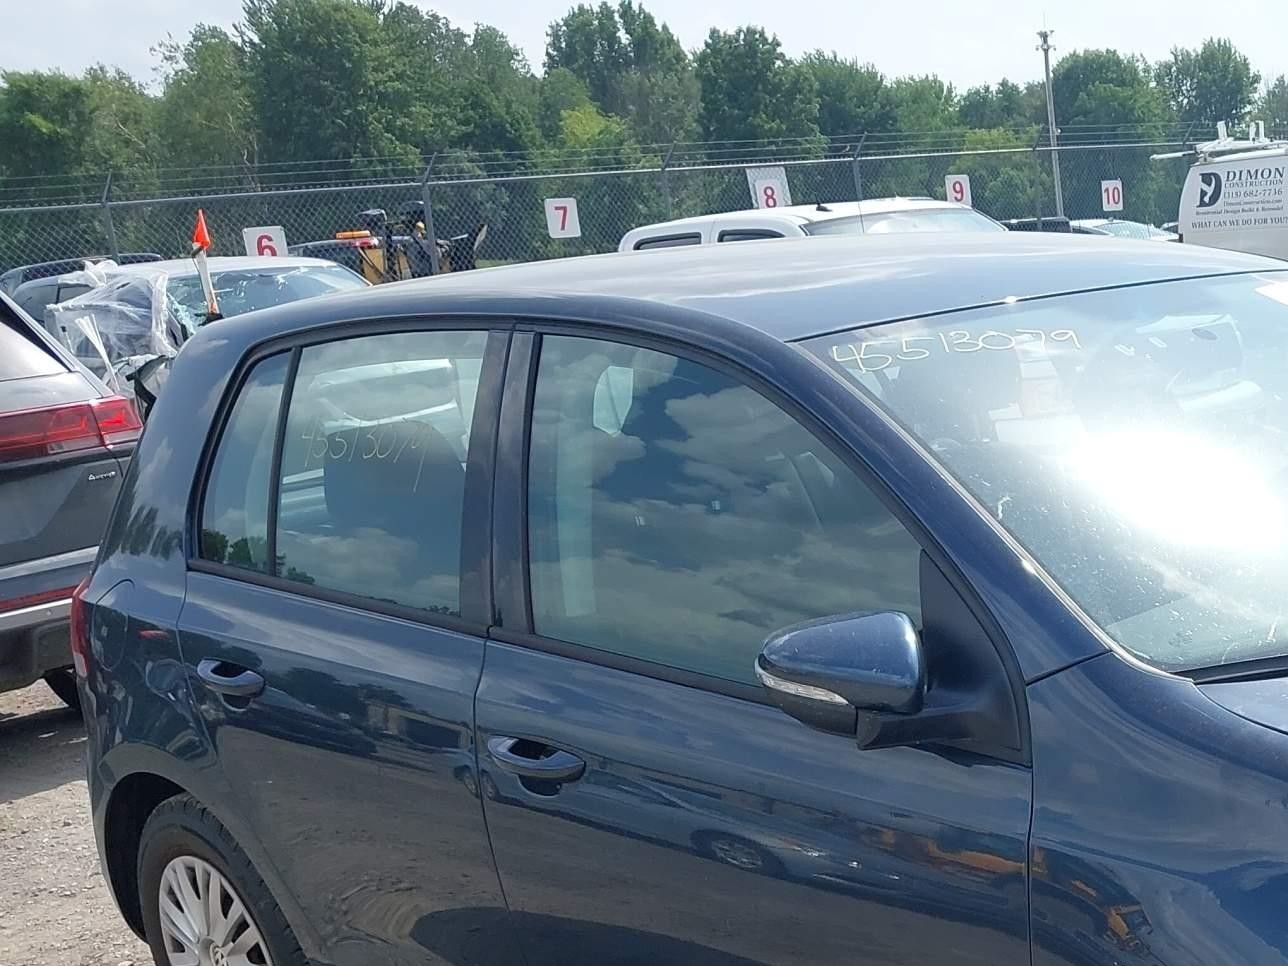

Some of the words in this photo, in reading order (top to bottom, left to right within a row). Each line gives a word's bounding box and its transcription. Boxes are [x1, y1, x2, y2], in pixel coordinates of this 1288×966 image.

[1224, 180, 1283, 189] CONSTRUCTION
[1226, 167, 1285, 182] DIMON
[763, 185, 777, 209] 8
[951, 180, 965, 203] 9
[1103, 184, 1122, 206] 10
[554, 205, 568, 231] 7
[1191, 221, 1211, 229] WHAT
[1228, 219, 1240, 227] WE
[1241, 218, 1252, 226] DO
[1253, 217, 1268, 225] FOR
[1270, 216, 1288, 225] YOU?
[256, 234, 277, 257] 6
[832, 328, 1082, 374] 45513079
